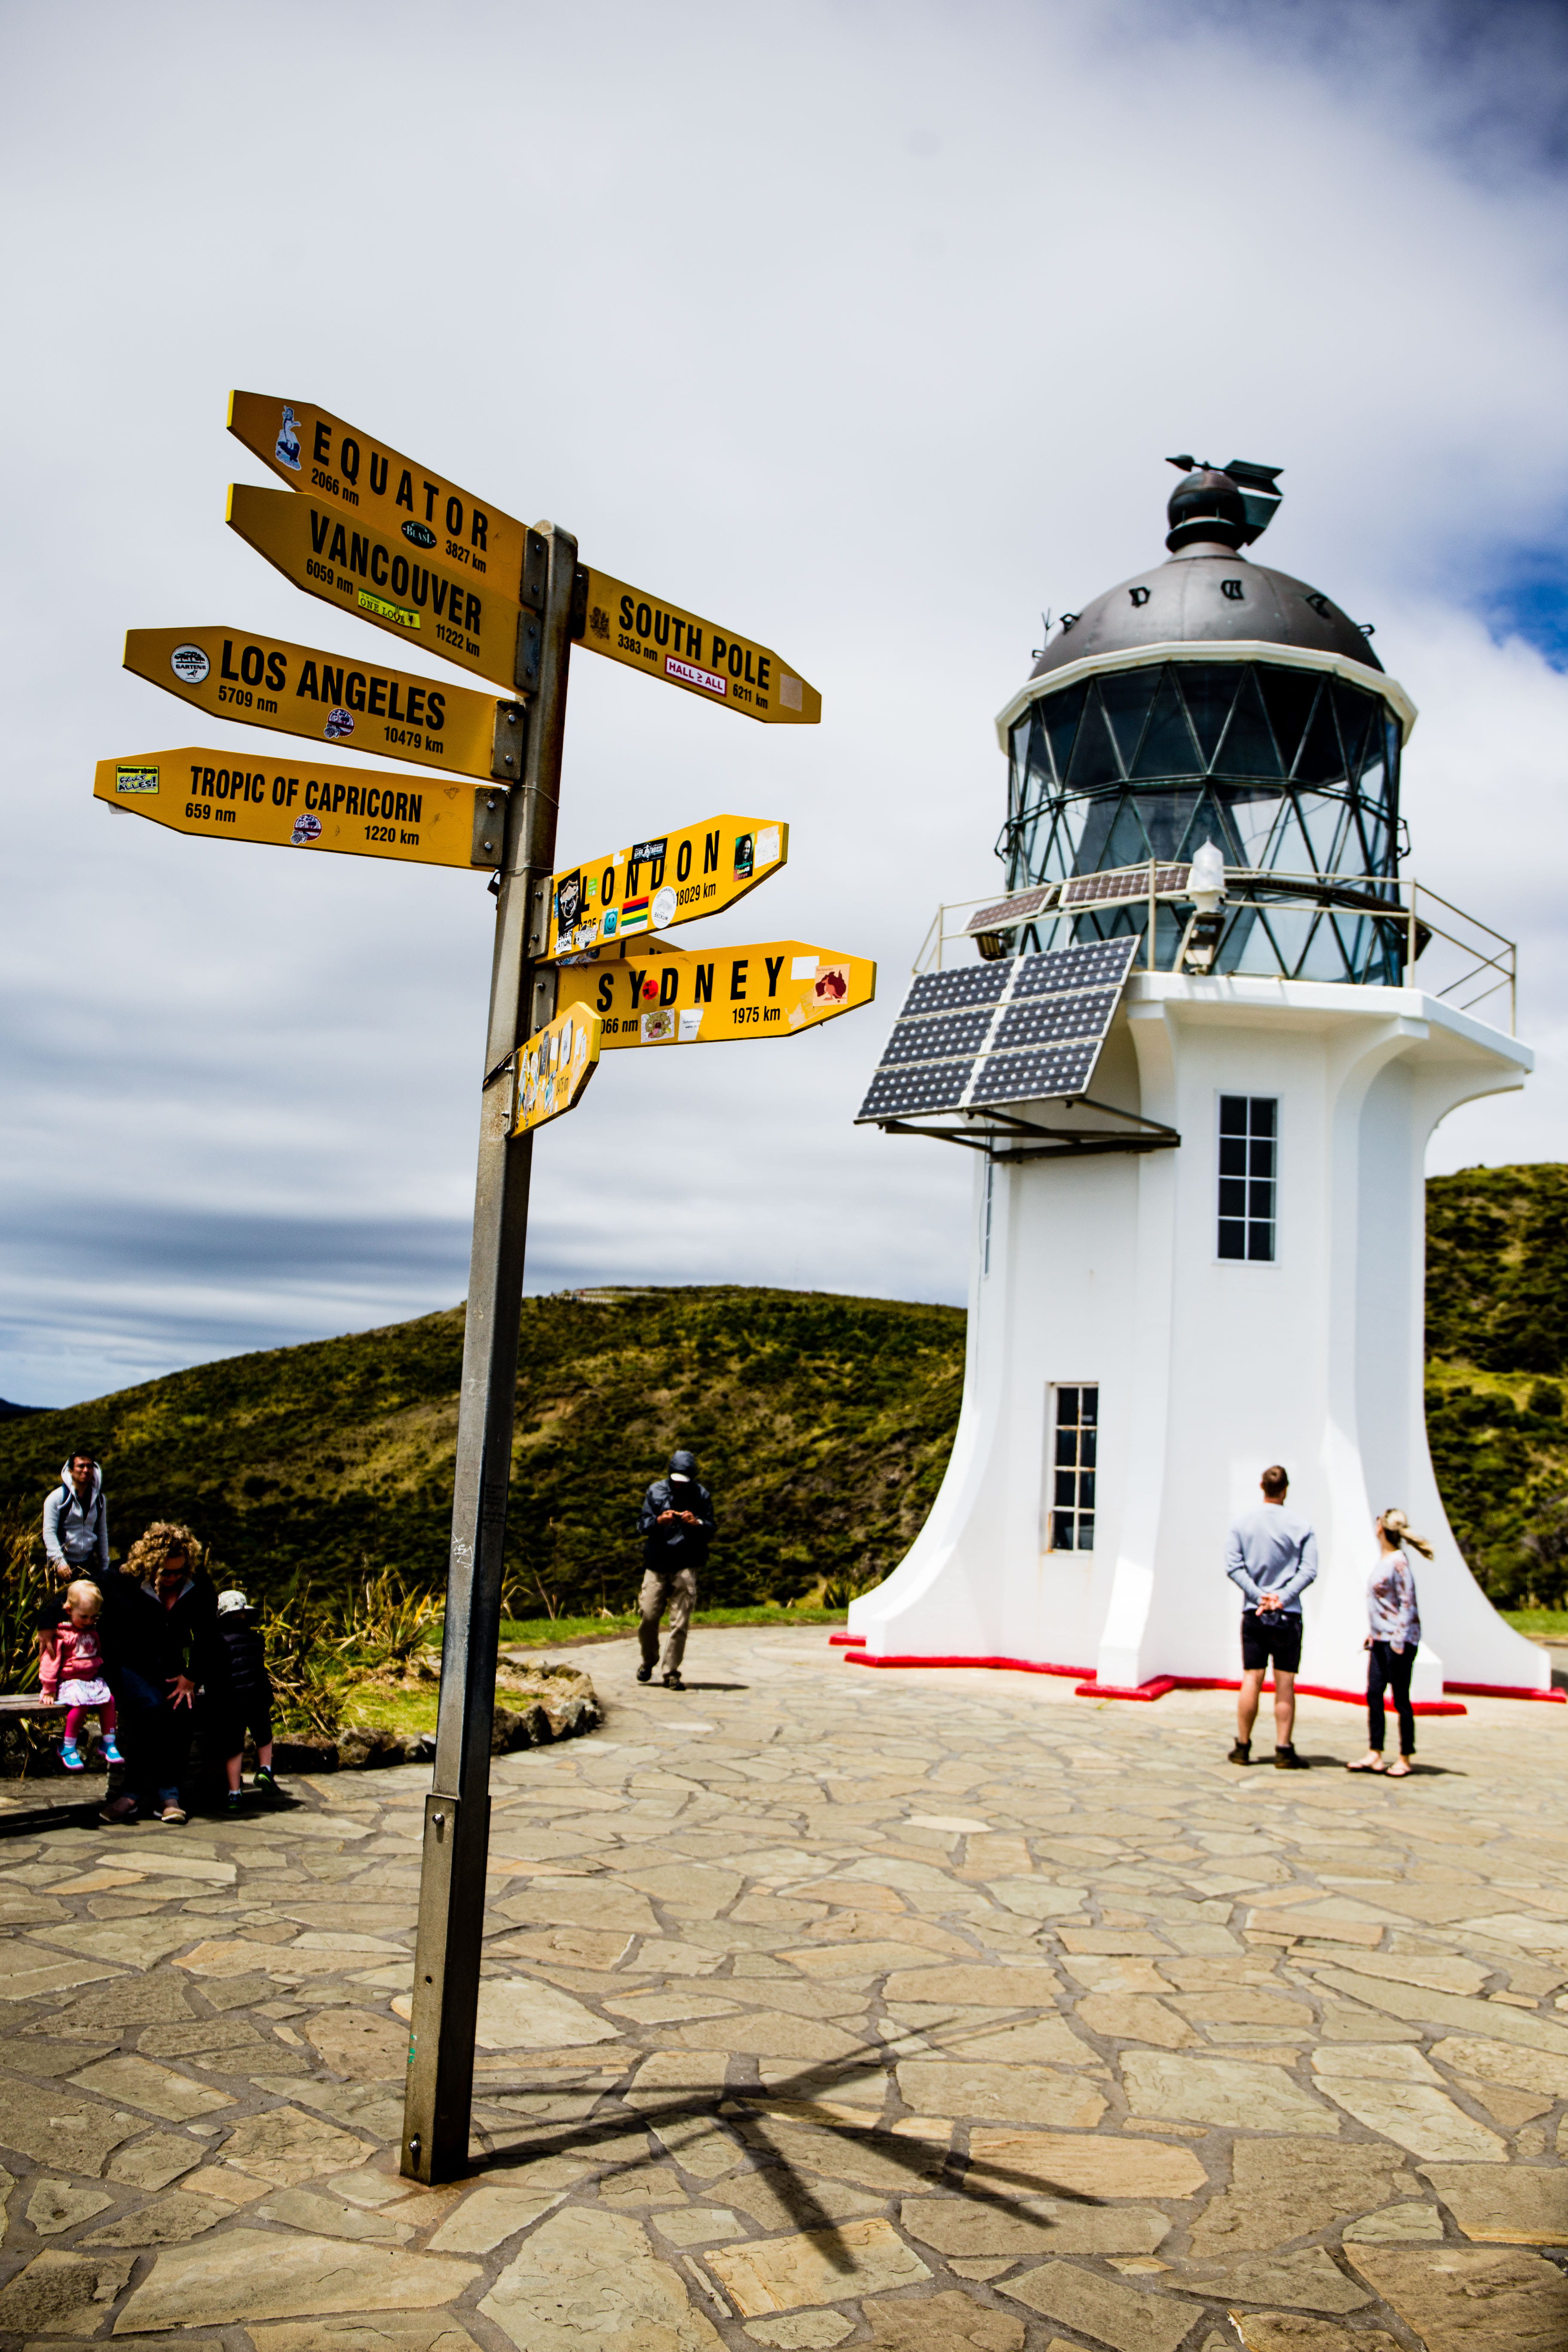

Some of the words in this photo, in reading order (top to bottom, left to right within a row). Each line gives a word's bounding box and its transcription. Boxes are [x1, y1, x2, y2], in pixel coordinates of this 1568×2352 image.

[311, 468, 339, 496] 2066
[342, 487, 359, 506] nm
[313, 420, 488, 552] EQUATOR
[445, 539, 470, 564] 3827
[472, 553, 486, 573] km
[306, 558, 334, 585] 6059
[337, 576, 353, 595] nm
[310, 508, 482, 636] VANCOUVER
[360, 598, 379, 612] ONE
[436, 623, 464, 649] 11222
[466, 637, 480, 657] km
[618, 634, 641, 655] 3383
[643, 646, 658, 662] nm
[619, 595, 702, 661] SOUTH
[711, 635, 770, 691] POLE
[220, 639, 287, 692] LOS
[296, 660, 446, 731] ANGELES
[669, 661, 694, 679] HALL
[705, 677, 723, 690] ALL
[218, 685, 253, 707] 5709
[257, 698, 278, 714] nm
[733, 683, 752, 702] 6211
[756, 692, 768, 709] km
[384, 726, 422, 748] 10479
[425, 735, 444, 754] km
[118, 775, 156, 791] ALLES!
[190, 766, 265, 803] TROPIC
[272, 776, 299, 807] OF
[305, 780, 422, 823] CAPRICORN
[185, 802, 211, 820] 659
[215, 809, 236, 823] nm
[364, 825, 396, 842] 1220
[400, 829, 419, 845] km
[581, 830, 720, 913] LONDON
[676, 885, 700, 906] 18029
[703, 882, 716, 898] km
[654, 912, 668, 921] BECKUM
[597, 956, 784, 1013] SYDNEY
[622, 1019, 638, 1032] nm
[732, 1007, 759, 1024] 1975
[763, 1005, 780, 1021] km
